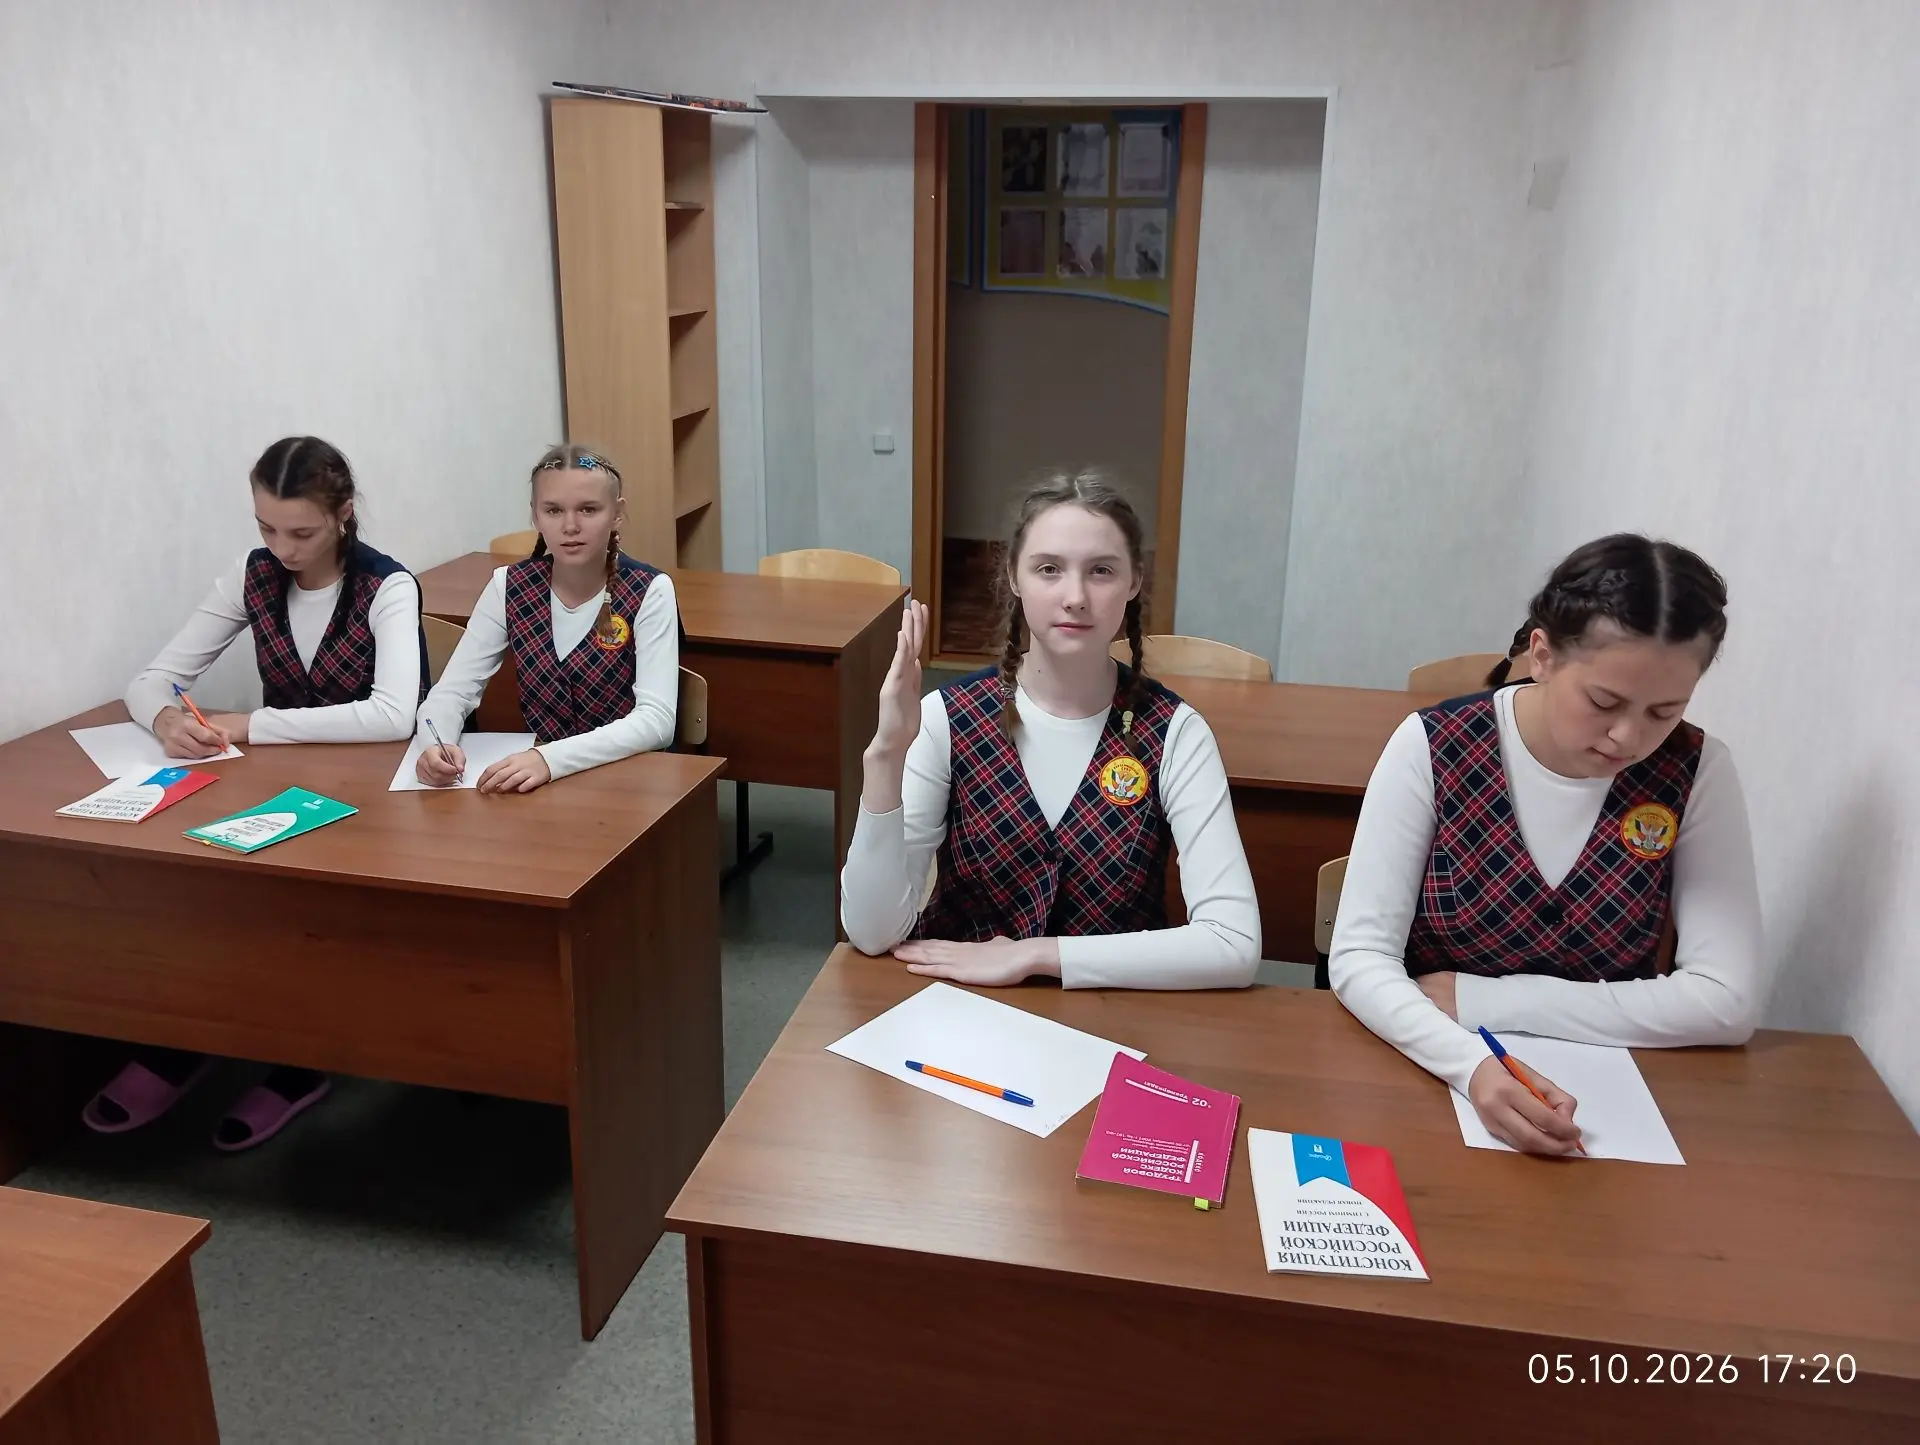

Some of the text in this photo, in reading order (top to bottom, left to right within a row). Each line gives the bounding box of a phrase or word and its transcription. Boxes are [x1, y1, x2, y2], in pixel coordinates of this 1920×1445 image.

[1110, 1152, 1185, 1169] РОССИЙСКОЙ
[1120, 1147, 1187, 1162] ФЕДЕРАЦИИ
[1122, 1167, 1182, 1182] ТРУДОВОЙ
[1140, 1163, 1183, 1175] КОДЕКС
[1283, 1220, 1390, 1237] ФЕДЕРАЦИИ
[1279, 1236, 1402, 1255] РОССИЙСКОЙ
[1276, 1251, 1413, 1272] КОНСТИТУЦИЯ
